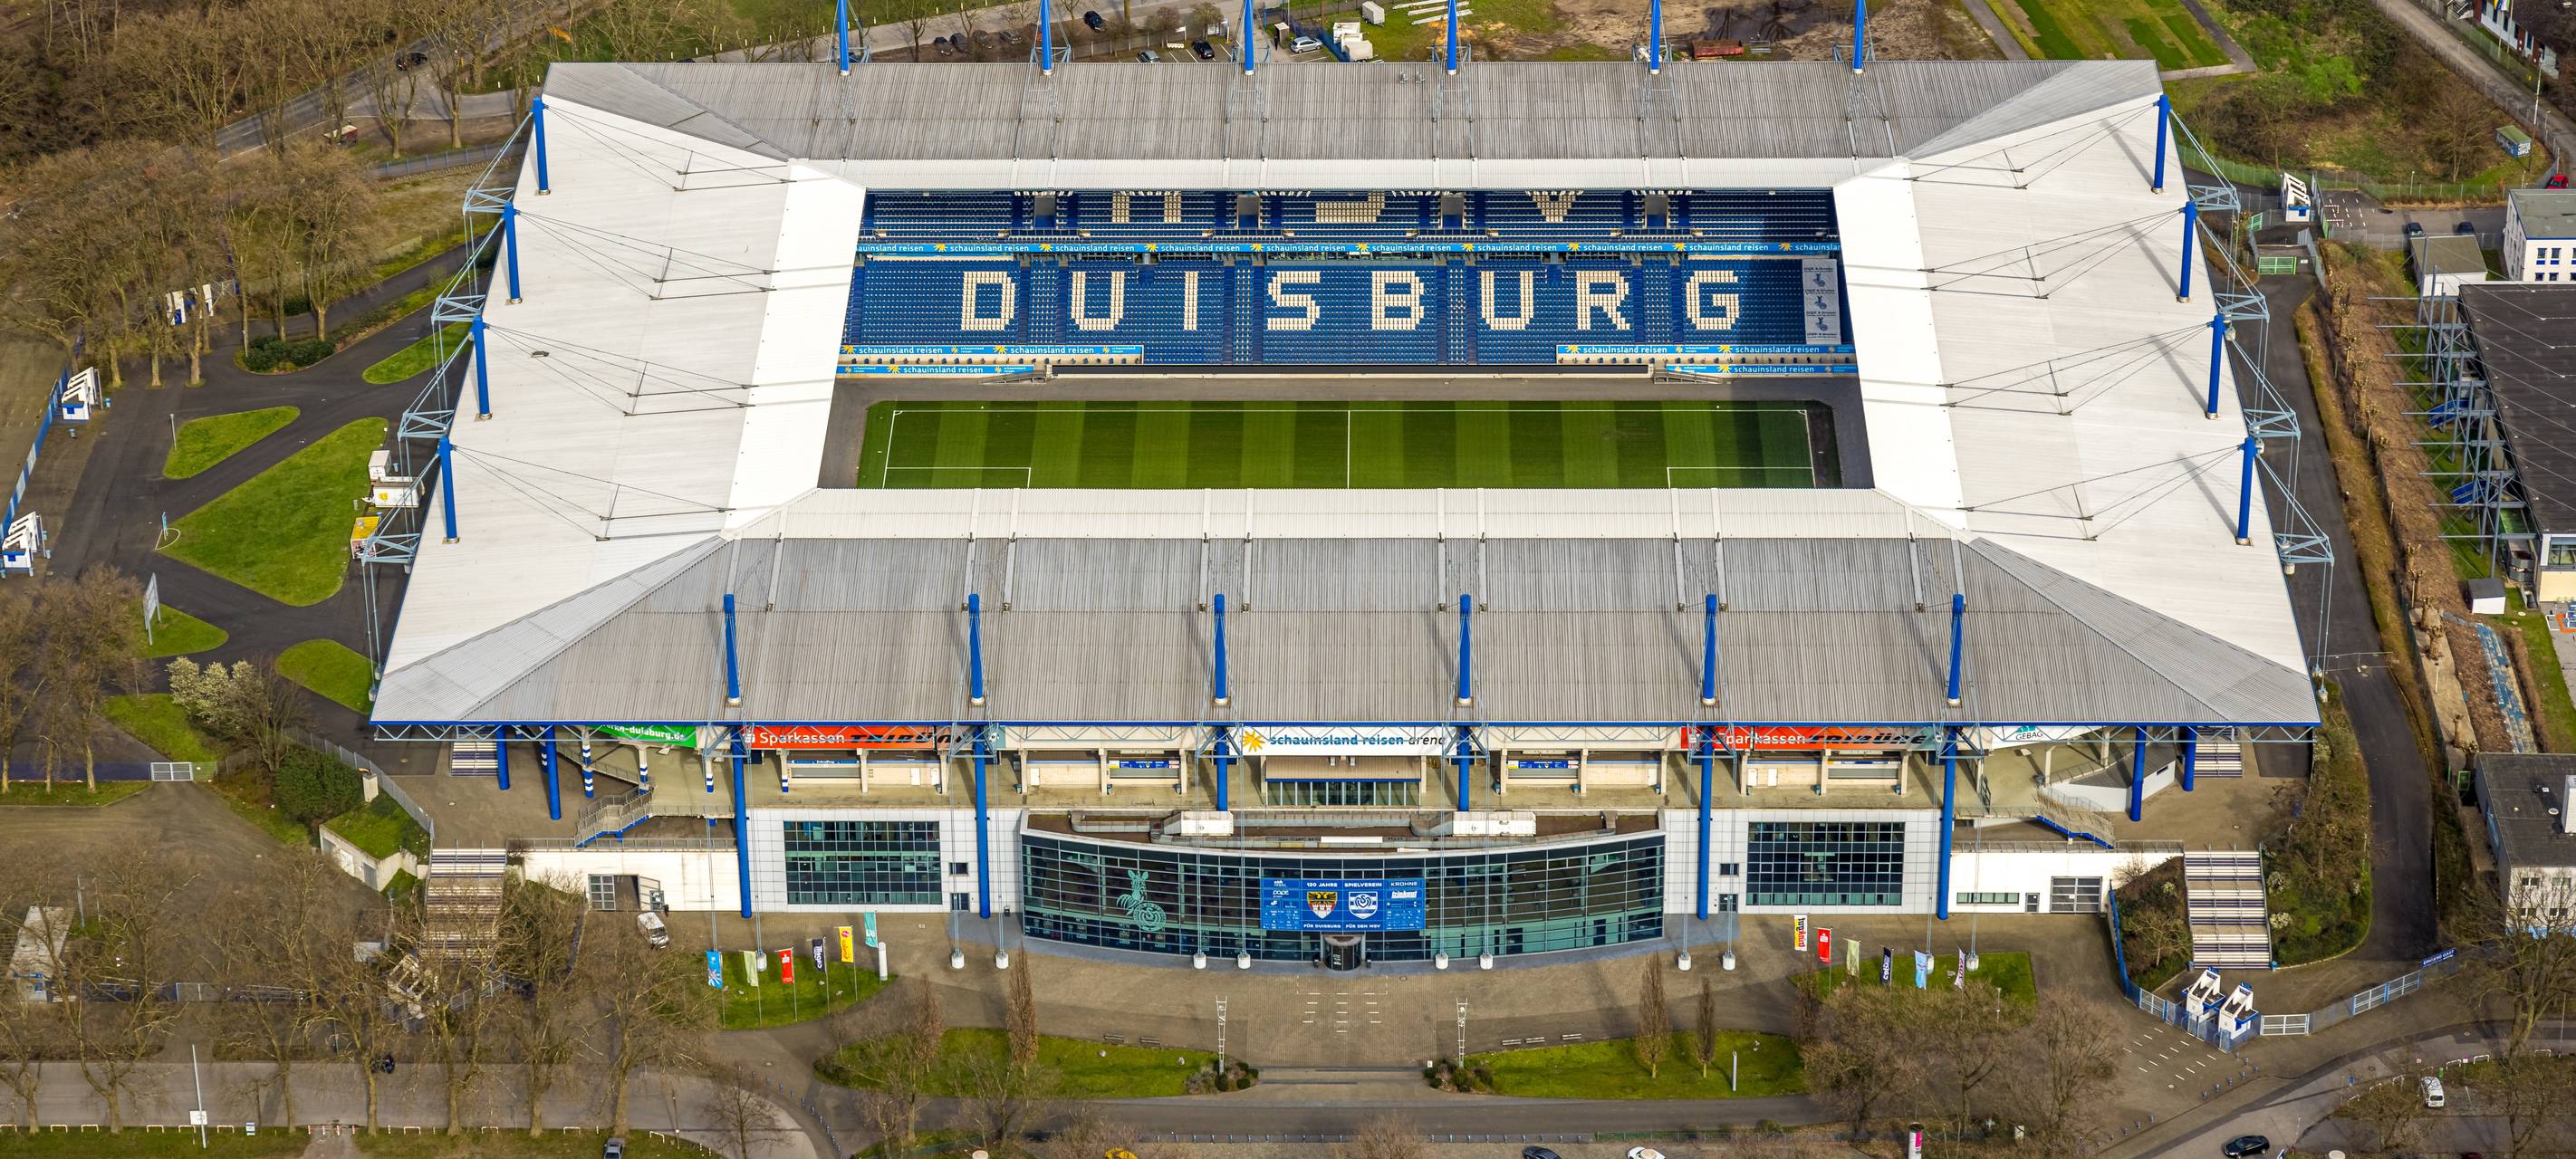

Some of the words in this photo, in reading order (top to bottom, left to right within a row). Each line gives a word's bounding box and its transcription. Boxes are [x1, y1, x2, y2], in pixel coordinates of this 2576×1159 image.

[961, 271, 1739, 330] DUISBURG
[860, 346, 914, 354] schauinsland
[917, 346, 942, 354] reisen
[1011, 346, 1065, 354] schauinsland
[1068, 346, 1093, 354] reisen
[904, 365, 956, 373] schauinsland
[958, 365, 983, 373] reisen
[760, 732, 844, 746] Sparkassen
[851, 733, 963, 742] TRIBÜN
[1270, 734, 1359, 745] schauinsland
[1362, 734, 1404, 745] reisen
[2016, 731, 2043, 741] GEBAG
